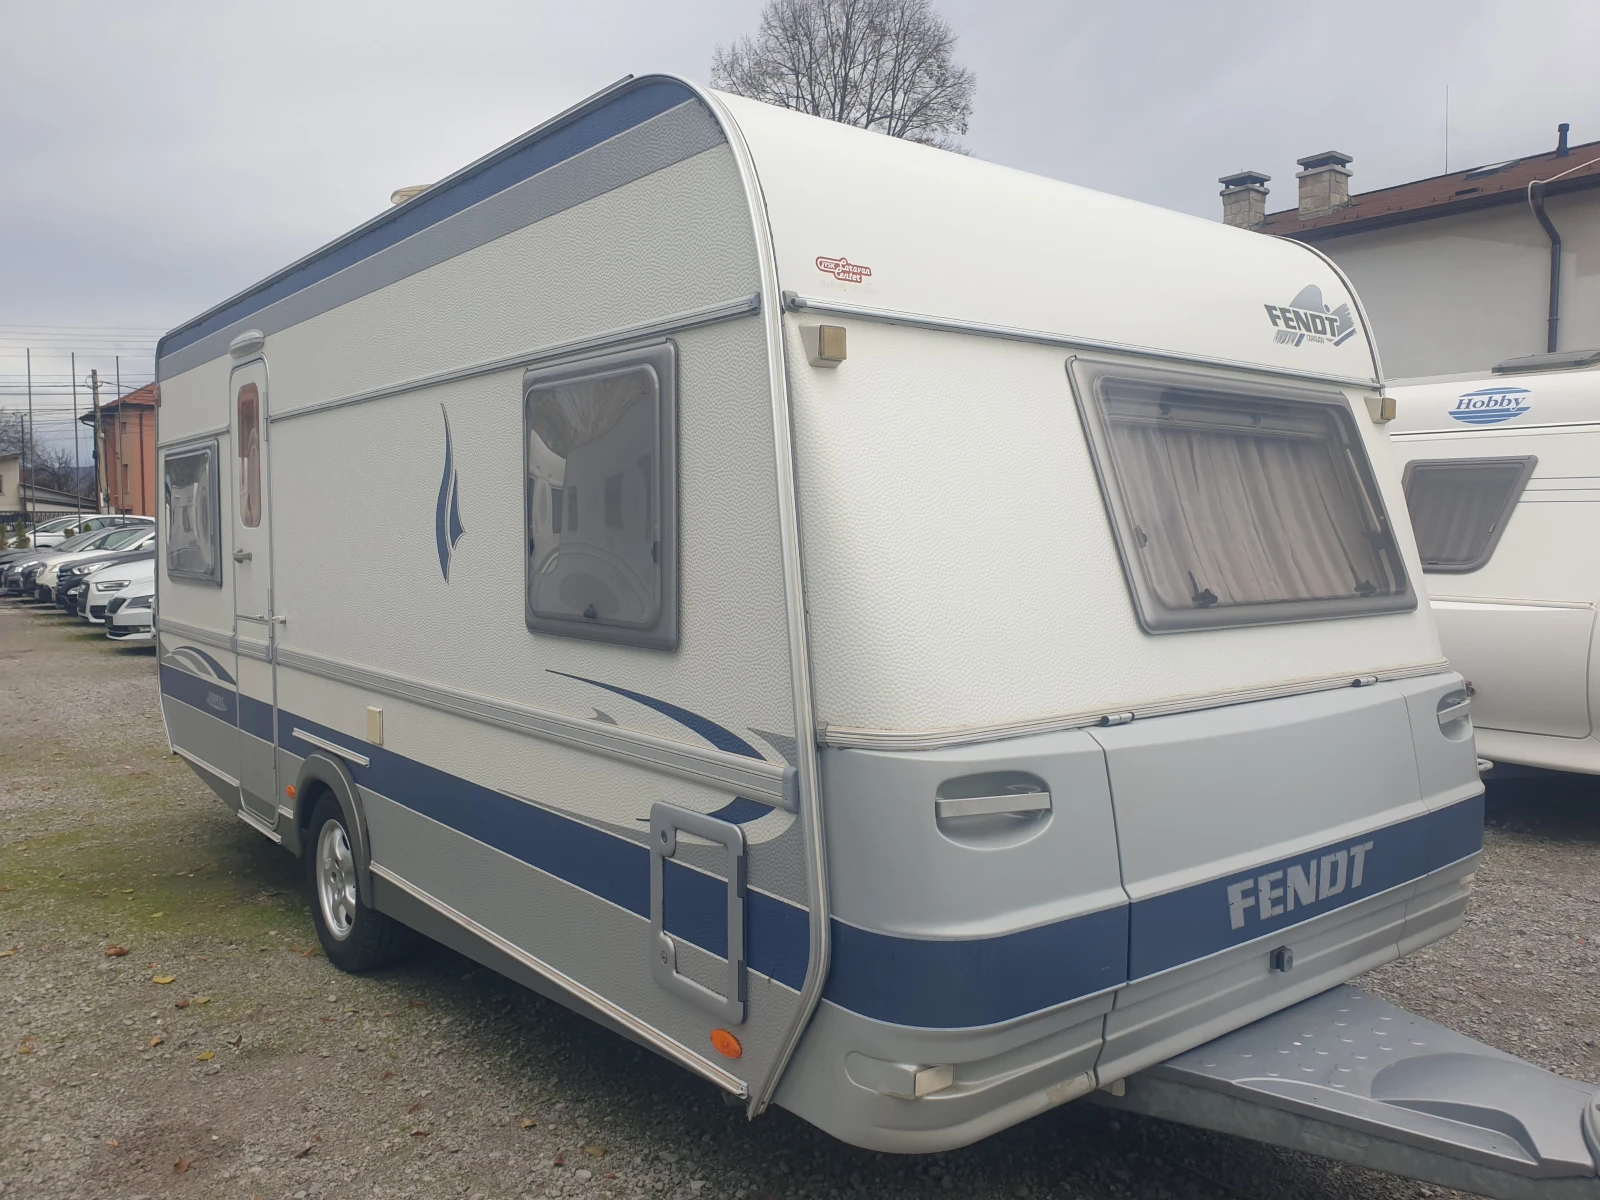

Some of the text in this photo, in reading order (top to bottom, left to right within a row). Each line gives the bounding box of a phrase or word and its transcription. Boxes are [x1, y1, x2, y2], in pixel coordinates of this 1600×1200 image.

[835, 267, 862, 281] Center
[839, 259, 871, 275] Caravan
[1263, 303, 1338, 338] FENDT
[1455, 394, 1527, 411] Hobby
[1227, 840, 1374, 931] FENDT
